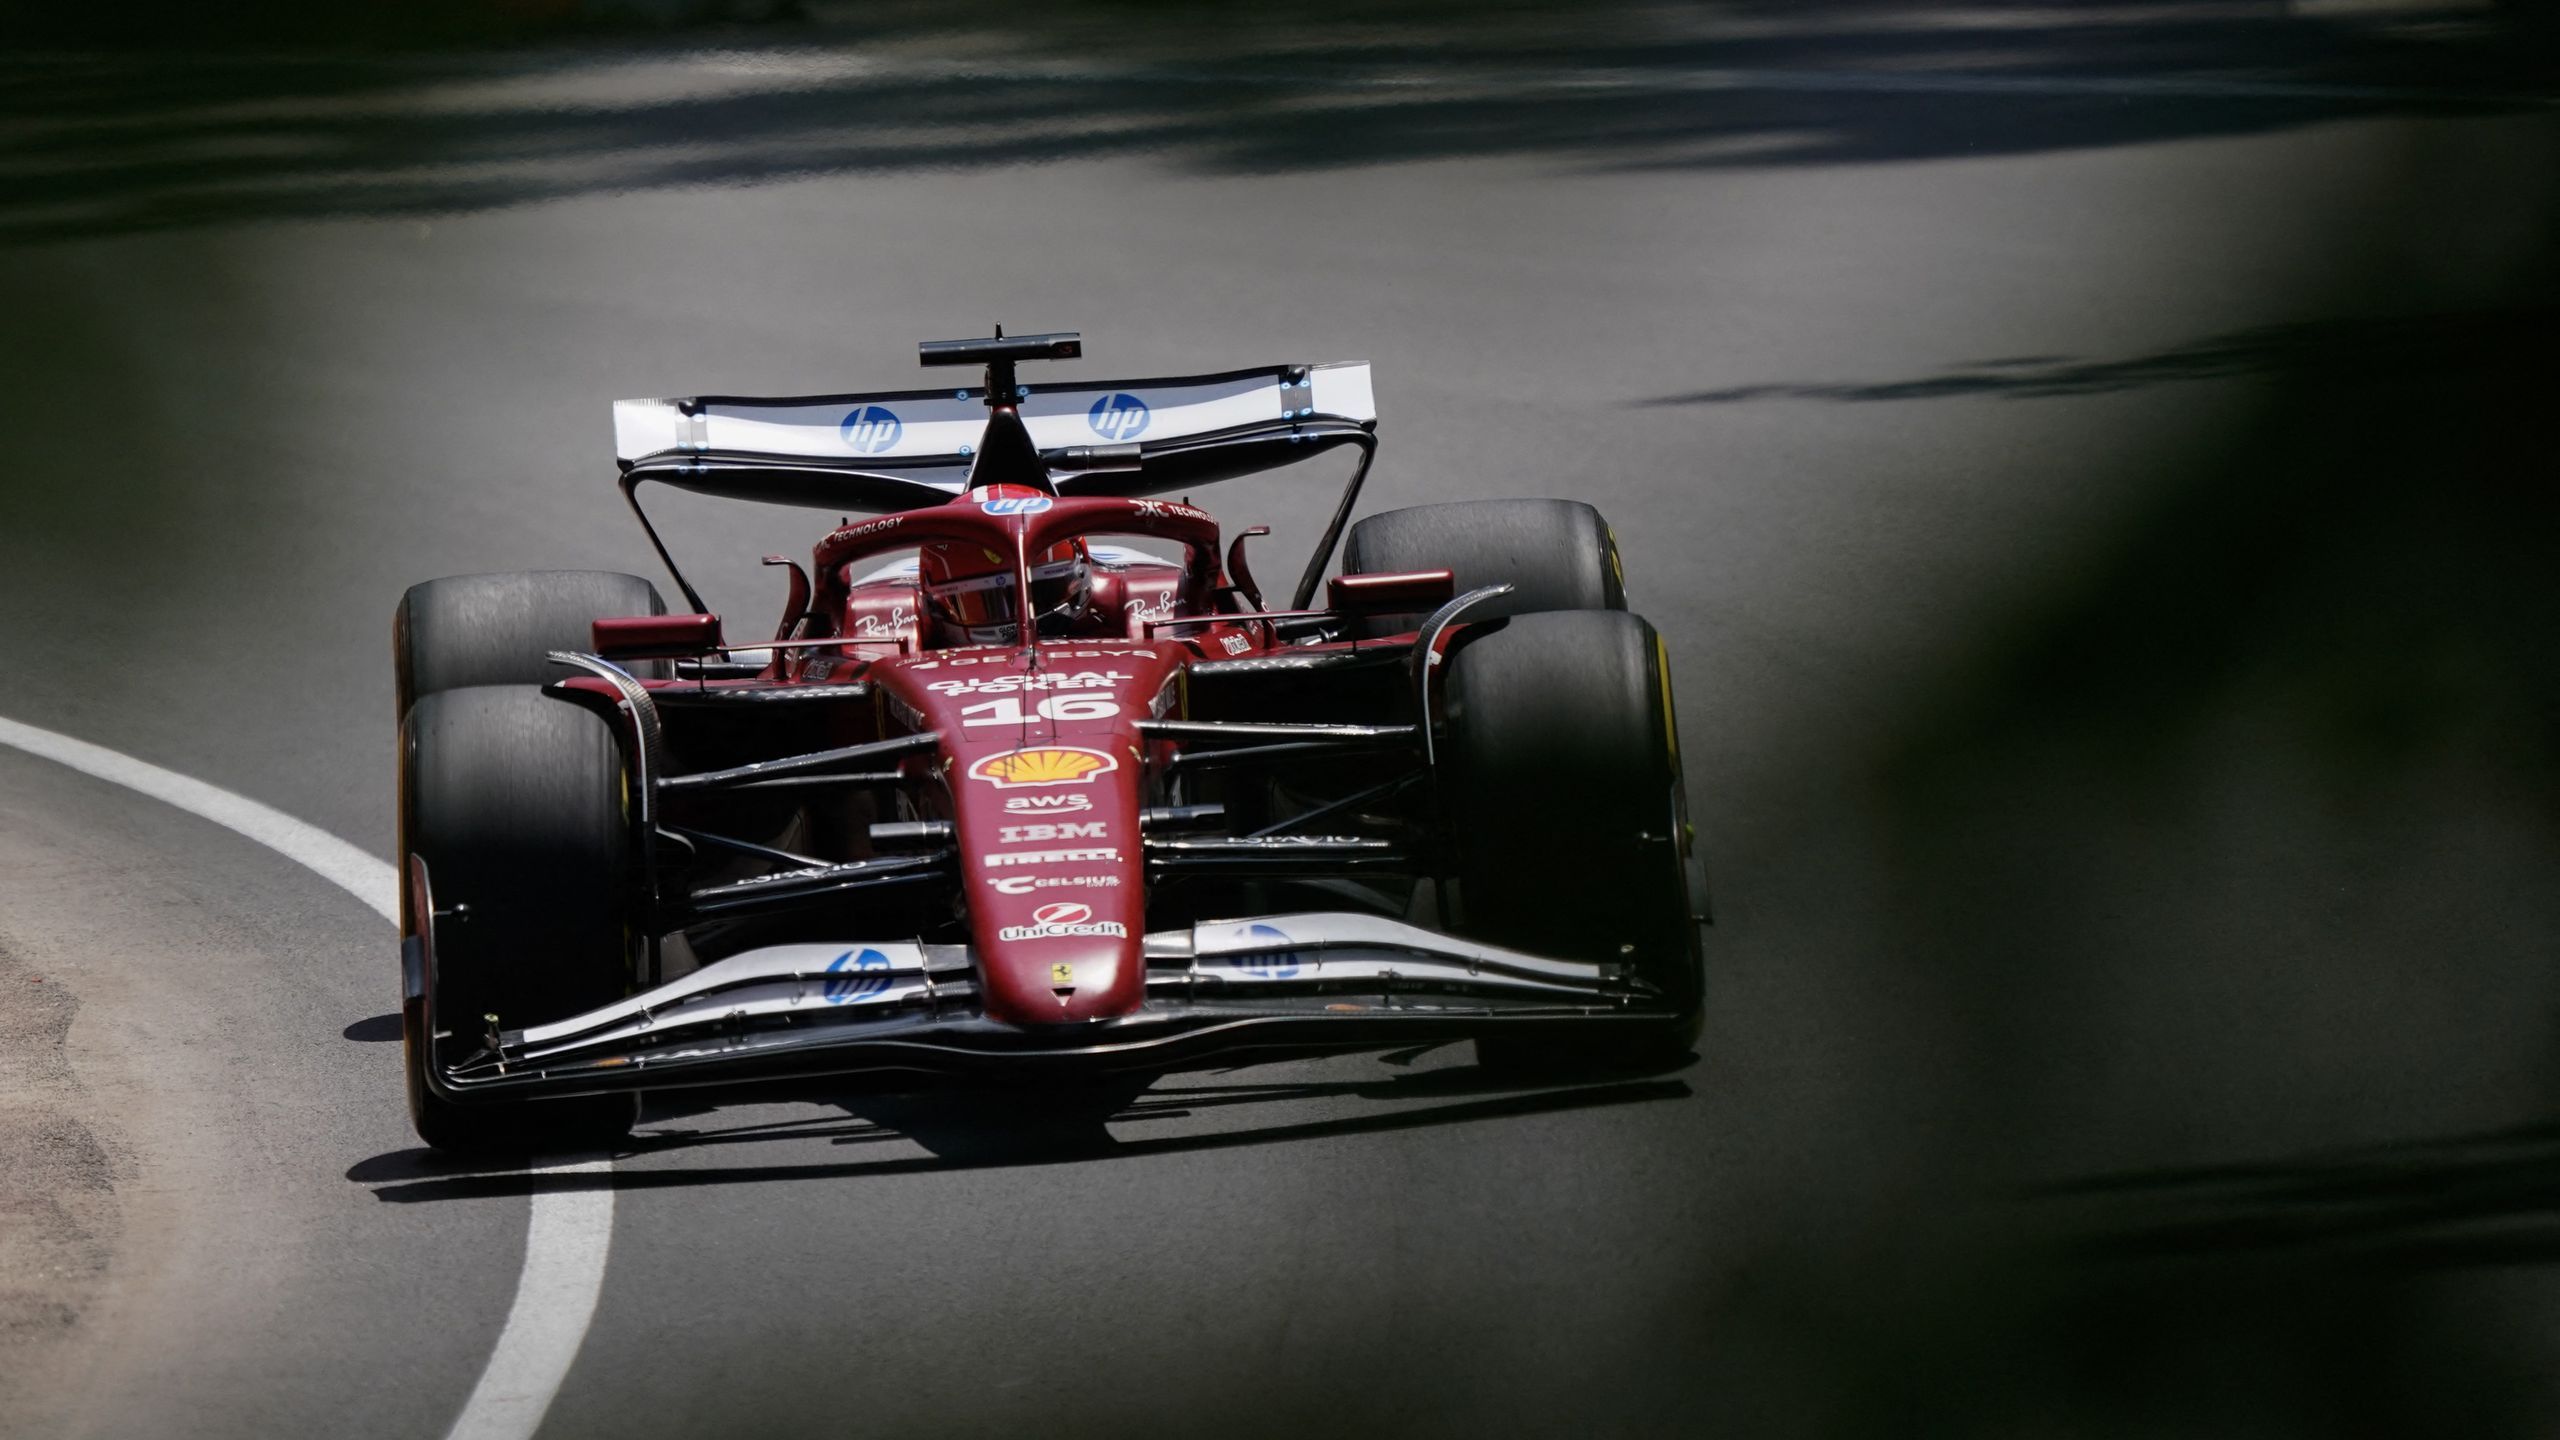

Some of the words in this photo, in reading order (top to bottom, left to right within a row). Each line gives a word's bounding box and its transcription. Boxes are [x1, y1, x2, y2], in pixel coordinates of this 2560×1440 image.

[1094, 394, 1144, 440] hp
[845, 406, 898, 453] hp
[834, 516, 904, 542] TECHNOLOGY
[856, 607, 919, 637] Ray-Ban
[926, 671, 1134, 691] GLOBAL
[944, 679, 1118, 697] POKER
[961, 692, 1120, 727] 16
[1004, 793, 1090, 809] aws
[999, 822, 1108, 843] IBM
[1002, 922, 1124, 940] UniCredit
